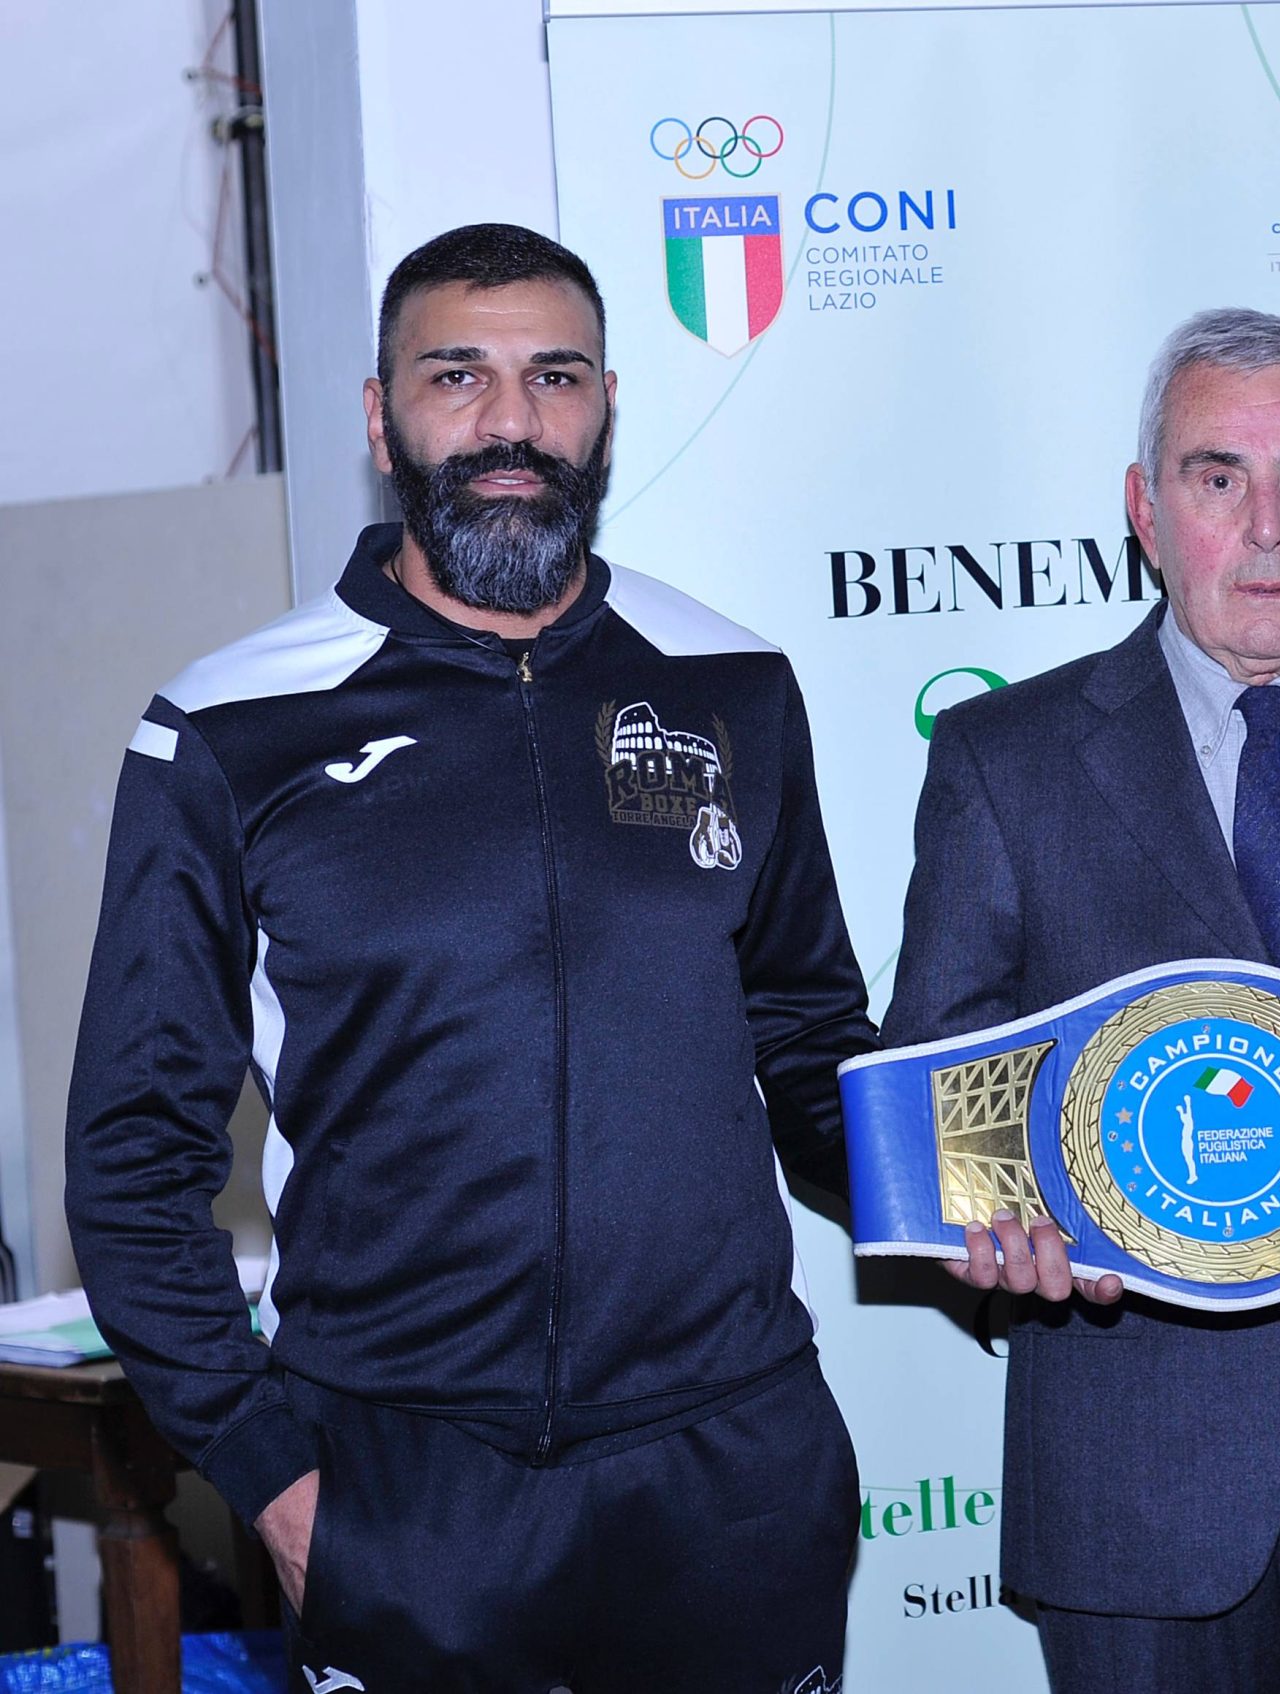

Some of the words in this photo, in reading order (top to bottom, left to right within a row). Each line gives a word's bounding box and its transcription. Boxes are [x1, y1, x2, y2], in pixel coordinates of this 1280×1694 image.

[673, 204, 773, 229] ITALIA
[803, 189, 957, 234] CONI
[805, 243, 929, 265] COMITATO
[806, 266, 944, 288] REGIONALE
[808, 291, 877, 312] LAZIO
[640, 793, 698, 816] BOXE
[1197, 1126, 1275, 1142] FEDERAZIONE
[1198, 1139, 1267, 1153] PUGILISTICA
[1199, 1151, 1249, 1165] ITALIANA
[861, 1475, 996, 1541] telle
[903, 1574, 1004, 1619] Stell
